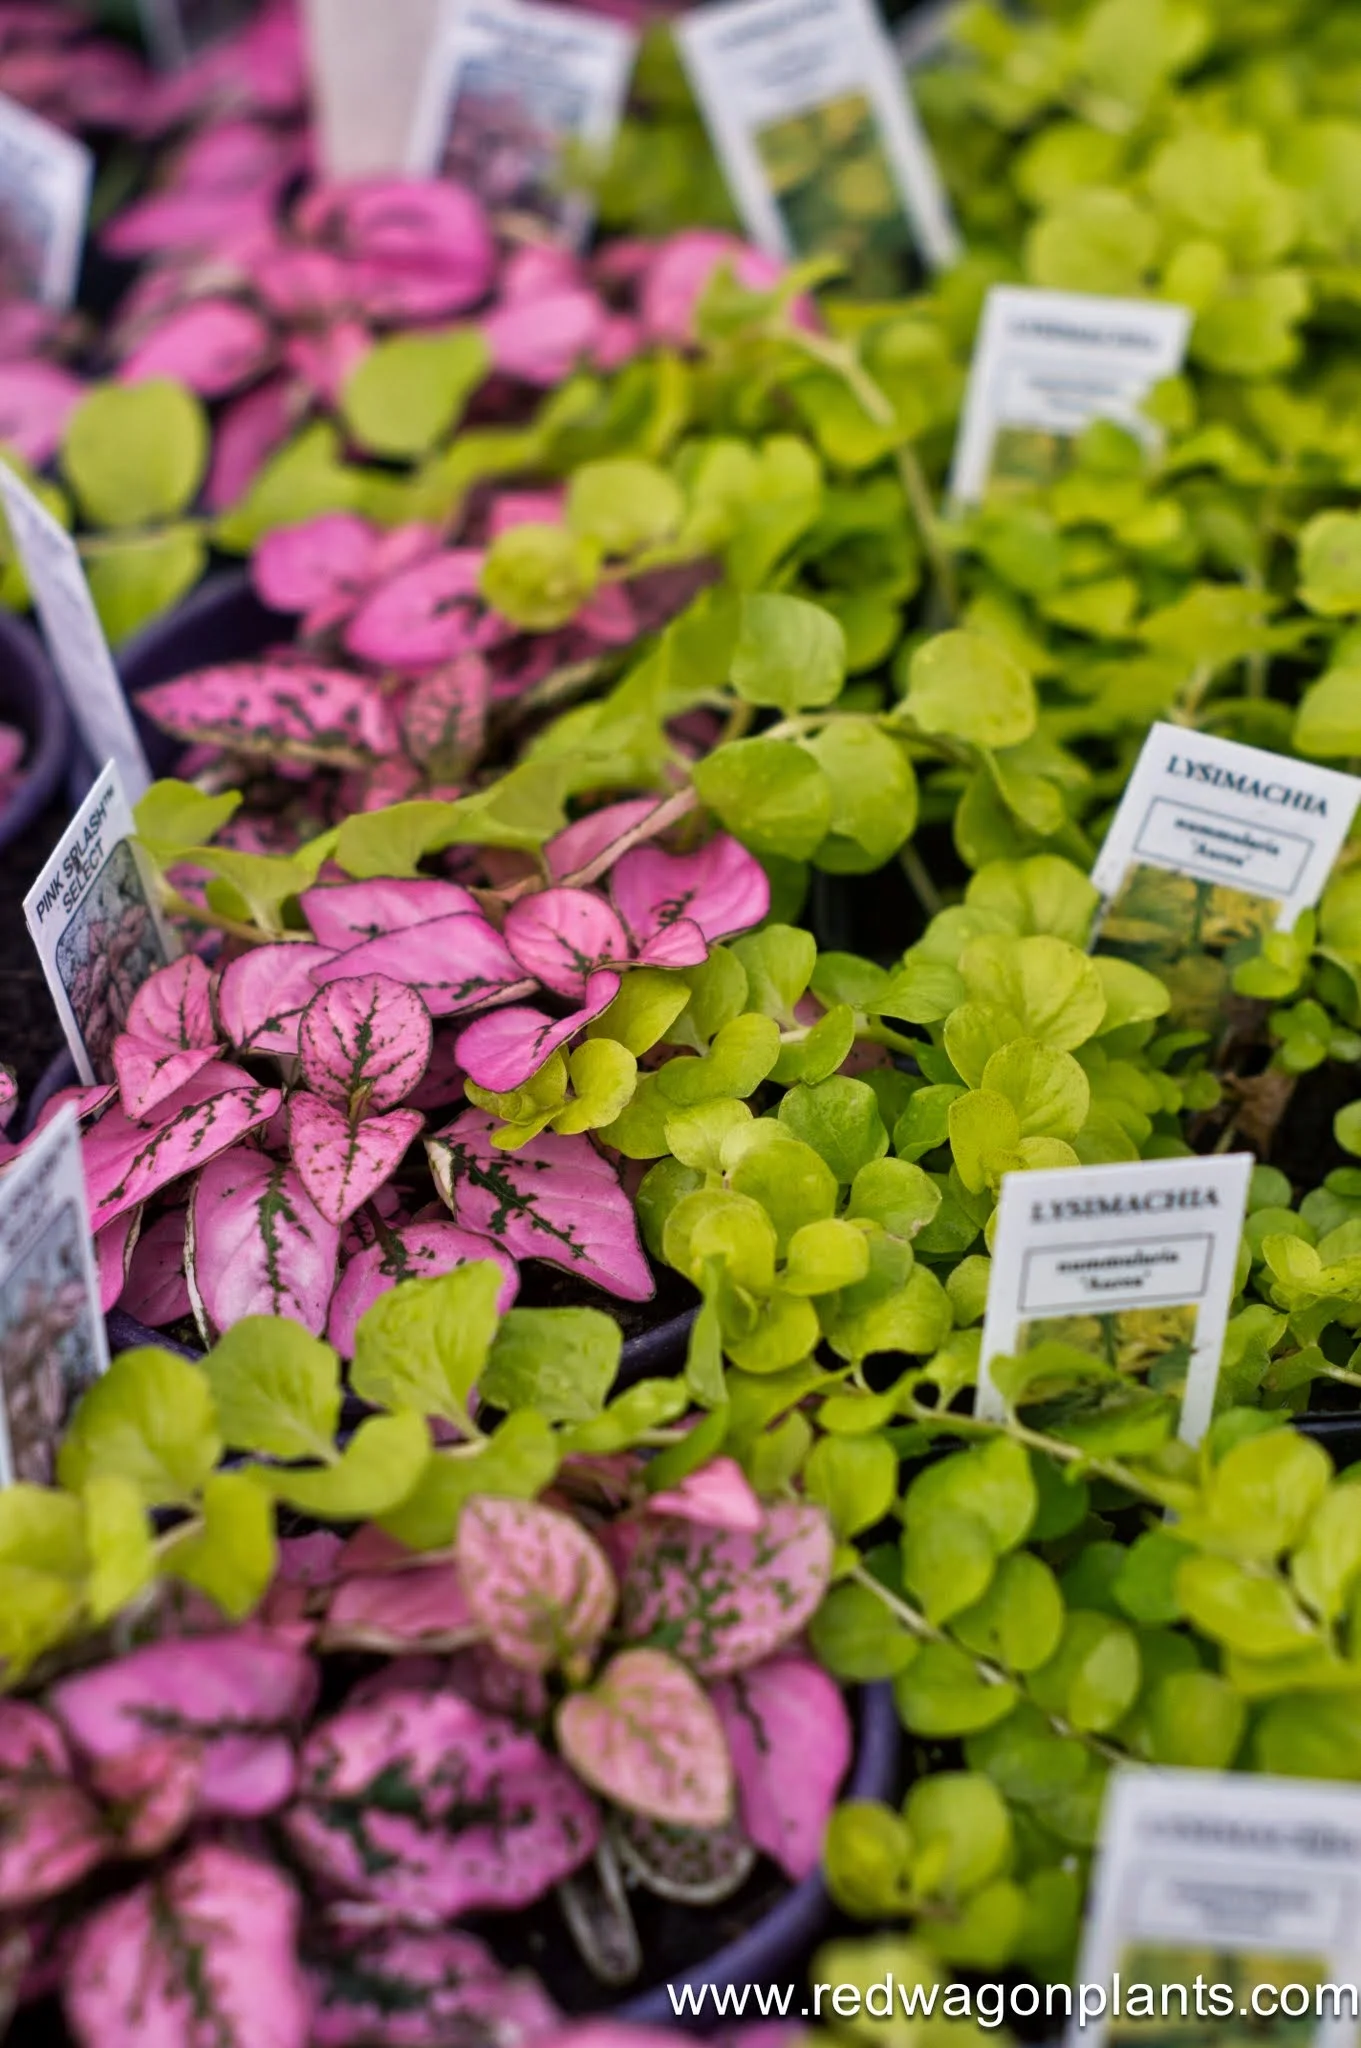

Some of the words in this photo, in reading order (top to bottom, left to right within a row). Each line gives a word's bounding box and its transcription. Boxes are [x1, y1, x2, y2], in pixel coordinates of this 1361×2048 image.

[1166, 755, 1328, 817] LYSIMACHIA
[36, 872, 65, 923] PINK
[63, 840, 105, 913] SELECT
[1030, 1186, 1220, 1224] LYSIMACHIA
